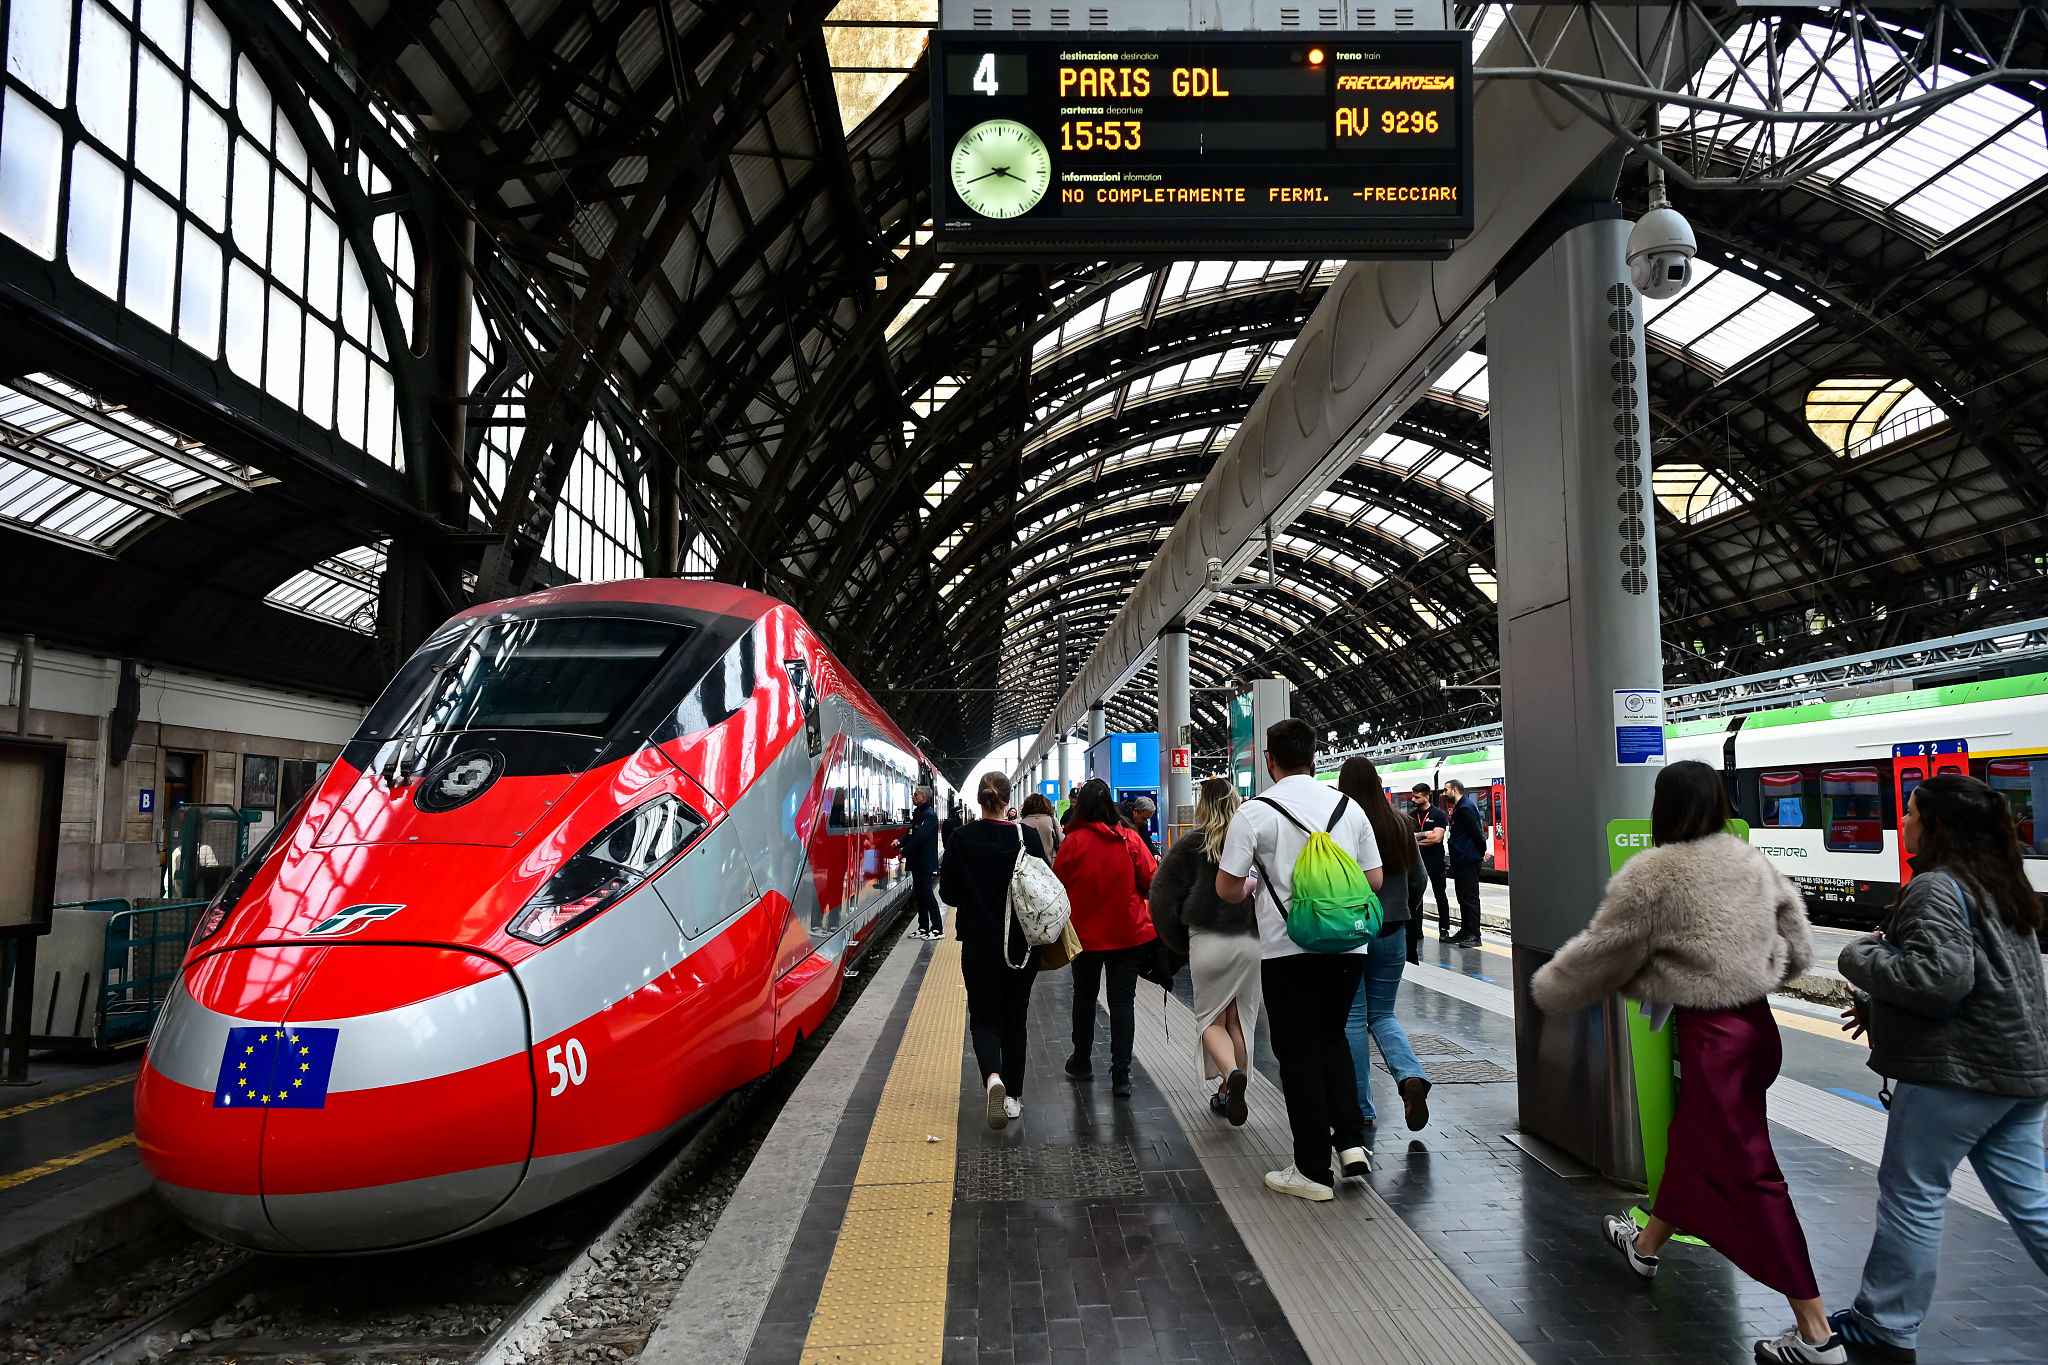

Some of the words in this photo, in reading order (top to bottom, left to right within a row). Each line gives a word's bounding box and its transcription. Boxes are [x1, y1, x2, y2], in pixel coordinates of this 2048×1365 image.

[1060, 51, 1119, 60] destinazione
[1121, 51, 1159, 60] destination
[1336, 52, 1362, 60] treno
[1364, 52, 1381, 60] train
[973, 53, 999, 96] 4
[1060, 68, 1150, 97] PARIS
[1172, 68, 1230, 97] GDL
[1337, 76, 1455, 90] FRECCIAROSSA
[1061, 105, 1104, 116] partenza
[1106, 105, 1143, 116] departure
[1336, 107, 1369, 137] AV
[1381, 110, 1439, 133] 9296
[1061, 121, 1142, 151] 15:53
[1062, 172, 1121, 182] informazioni
[1123, 173, 1162, 182] information
[1062, 188, 1084, 203] NO
[1097, 188, 1246, 203] COMPLETAMENTE
[1269, 187, 1329, 202] FERMI.
[1918, 744, 1925, 756] 2
[1931, 743, 1938, 755] 2
[143, 793, 150, 808] B
[546, 1038, 588, 1097] 50
